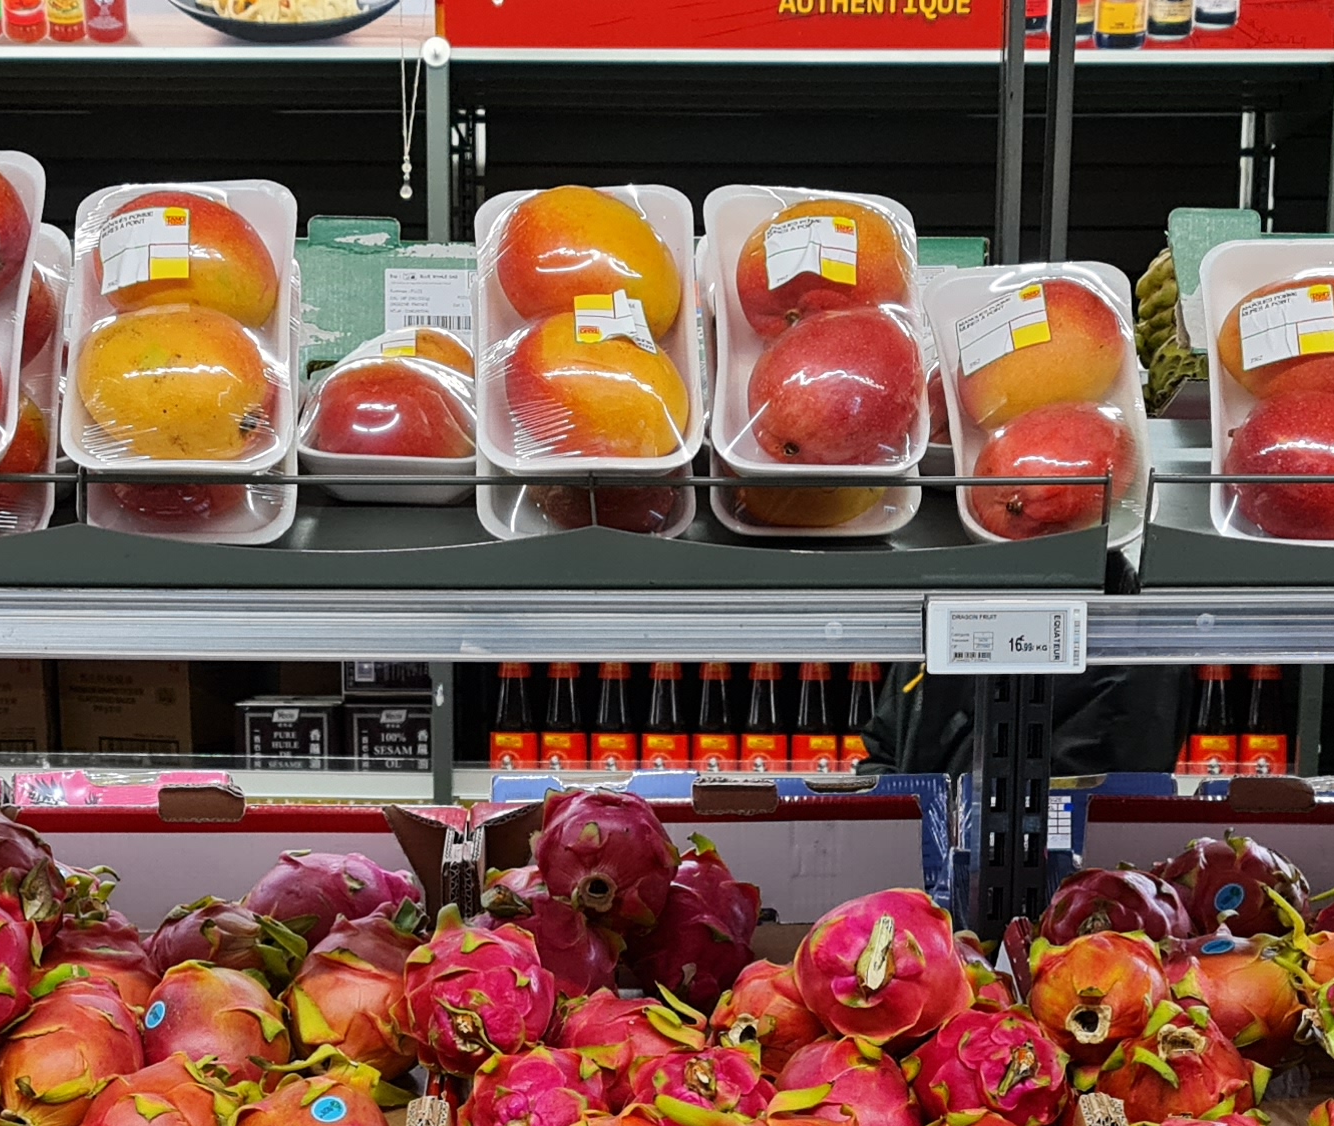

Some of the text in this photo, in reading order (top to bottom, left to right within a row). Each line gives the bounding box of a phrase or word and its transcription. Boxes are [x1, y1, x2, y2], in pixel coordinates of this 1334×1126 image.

[778, 0, 971, 20] AUTHENTIQUE
[1053, 615, 1061, 661] EQUATEUR
[1036, 644, 1048, 652] KG
[273, 731, 297, 740] PURE
[380, 732, 407, 743] 100%
[271, 741, 300, 750] HUILE
[373, 745, 413, 756] SESAM
[384, 759, 402, 769] OL
